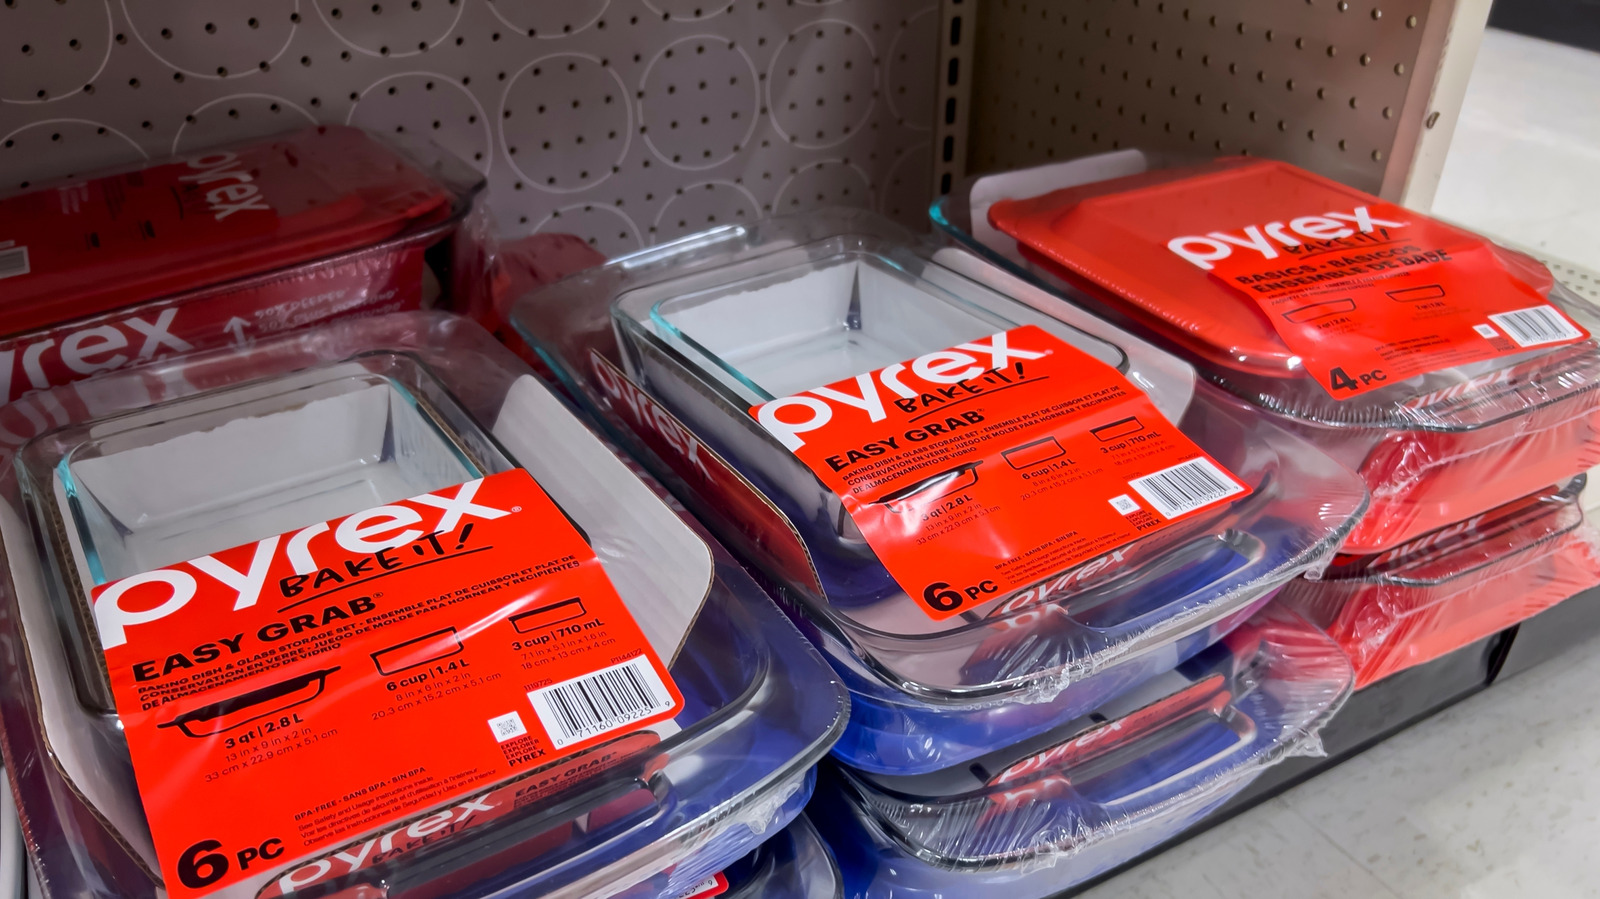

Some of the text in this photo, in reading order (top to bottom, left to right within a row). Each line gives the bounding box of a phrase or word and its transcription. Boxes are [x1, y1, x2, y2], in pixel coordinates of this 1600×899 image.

[1235, 245, 1422, 285] BASICS BÁSICOS
[1251, 266, 1370, 292] ENSEMBLE
[1371, 258, 1399, 271] DE
[1402, 249, 1452, 267] BASE
[894, 361, 1031, 413] BAKE IT!
[1329, 366, 1387, 391] 4 PC
[843, 464, 874, 481] BAKING
[874, 456, 895, 468] DISH
[902, 446, 929, 458] GLASS
[929, 435, 965, 450] STORAGE
[965, 431, 979, 439] SET
[984, 417, 1022, 433] ENSEMBLE
[1022, 411, 1039, 420] PLAT
[1051, 396, 1084, 411] CUISSON
[1093, 389, 1110, 398] PLAT
[847, 460, 912, 486] CONSERVATION
[925, 448, 952, 459] VERRE
[954, 438, 980, 450] JUEGO
[992, 425, 1018, 438] MOLDE
[1020, 419, 1040, 429] PARA
[1040, 407, 1075, 422] HORNEAR
[1081, 391, 1126, 408] RECIPIENTES
[1109, 441, 1126, 451] cup
[1130, 435, 1146, 446] 710
[1146, 431, 1162, 441] mL
[824, 436, 900, 472] EASY
[853, 485, 865, 494] DE
[866, 459, 939, 492] ALMACENAMIENTO
[950, 446, 976, 459] VIDRIO
[1031, 468, 1049, 477] cup
[1052, 461, 1068, 469] 1.4
[921, 513, 929, 521] 3
[930, 508, 943, 519] qt
[946, 497, 964, 510] 2.8
[1136, 519, 1162, 531] PYREX
[279, 523, 474, 598] BAKE IT!
[923, 580, 999, 612] 6 PC
[138, 555, 576, 693] BAKING DISH & GLASS STORAGE SET ENSEMBLE PLAT DE CUISSON ET PLAT DE
[140, 560, 580, 702] CONSERVATION EN VERRE JUEGO DE MOLDE PARA HORNEAR Y RECIPIENTES
[512, 618, 605, 651] 3 cup 710 mL
[132, 632, 245, 682] EASY
[386, 658, 470, 691] 6 cup 1.4 L
[141, 642, 341, 711] DE ALMACENAMIENTO DE VIDRIO
[371, 707, 395, 720] 20.3
[397, 700, 414, 712] cm
[423, 690, 443, 702] 15.2
[445, 684, 461, 696] cm
[471, 677, 484, 687] 5.1
[485, 672, 502, 682] cm
[224, 713, 304, 749] 3 qt 2.8 L
[576, 719, 614, 738] 71160
[618, 707, 651, 723] 09225
[205, 771, 220, 782] 33
[221, 764, 240, 776] cm
[250, 751, 274, 765] 22.9
[276, 744, 294, 756] cm
[304, 734, 319, 746] 5.1
[321, 728, 338, 739] cm
[225, 754, 238, 762] 13
[240, 748, 250, 757] in
[271, 737, 281, 746] in
[292, 730, 299, 739] 2
[301, 727, 312, 736] in
[501, 735, 532, 749] EXPLORE
[502, 739, 540, 754] EXPLORER
[505, 746, 537, 760] EXPLORE
[508, 749, 546, 767] PYREX
[294, 766, 426, 821] BPA-FREE SANS BPA SIN BPA
[515, 774, 562, 797] EASY
[177, 837, 285, 891] 6 PC
